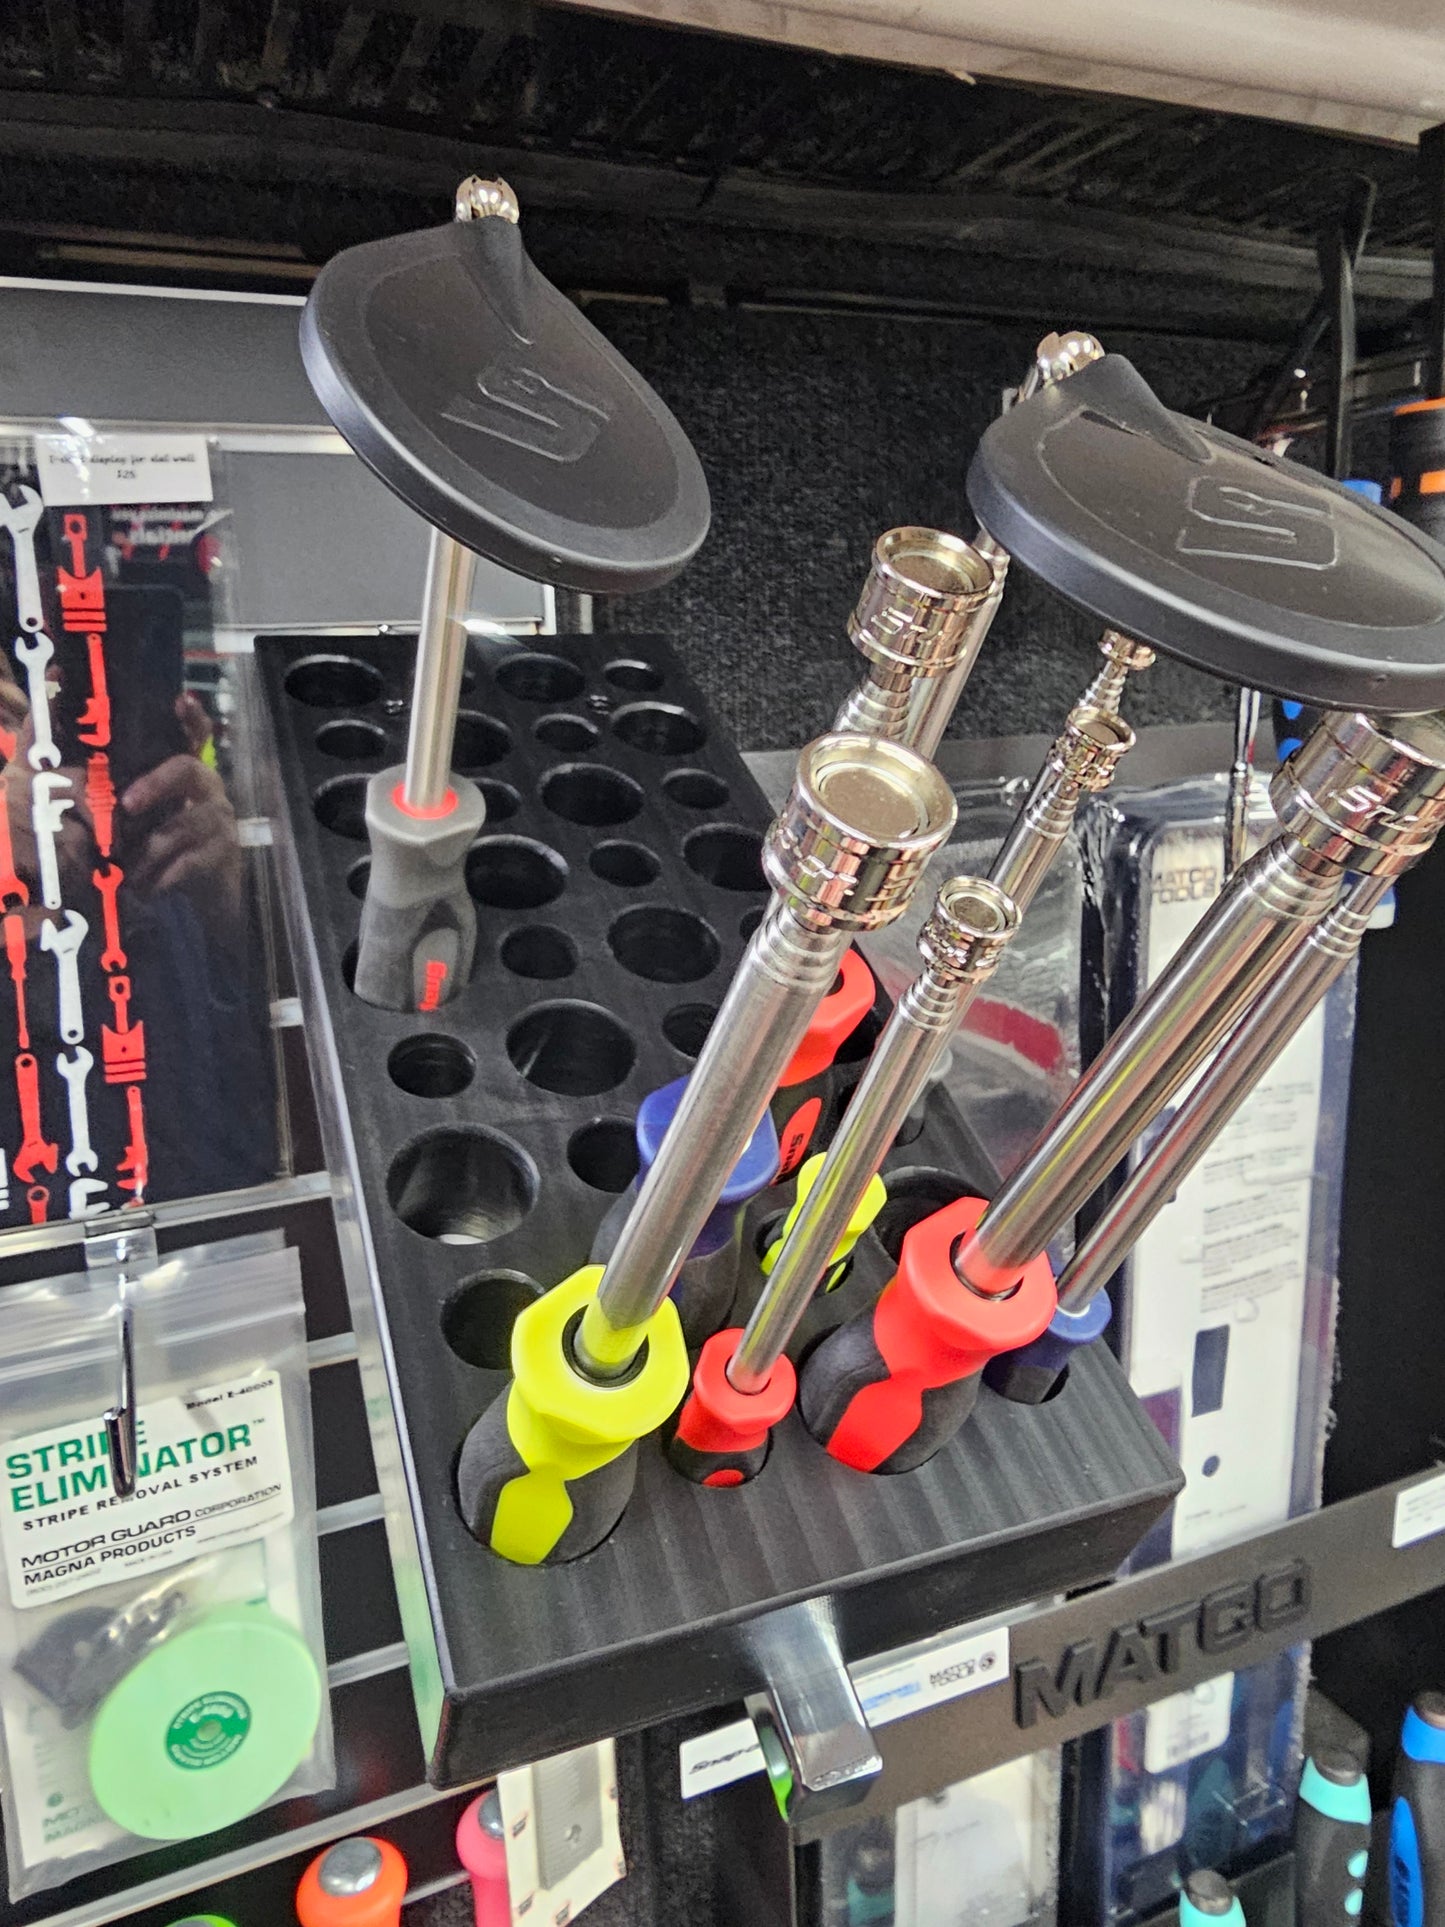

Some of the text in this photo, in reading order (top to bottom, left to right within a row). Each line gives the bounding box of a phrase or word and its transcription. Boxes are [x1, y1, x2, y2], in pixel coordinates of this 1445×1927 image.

[21, 1534, 106, 1568] MOTOR
[111, 1509, 191, 1542] GUARD
[194, 1483, 282, 1518] CORPORATION
[23, 1504, 90, 1531] STRIPE
[189, 1456, 258, 1484] SYSTEM
[24, 1556, 96, 1586] MAGNA
[100, 1526, 196, 1563] PRODUCTS
[1014, 1558, 1312, 1730] MATCO
